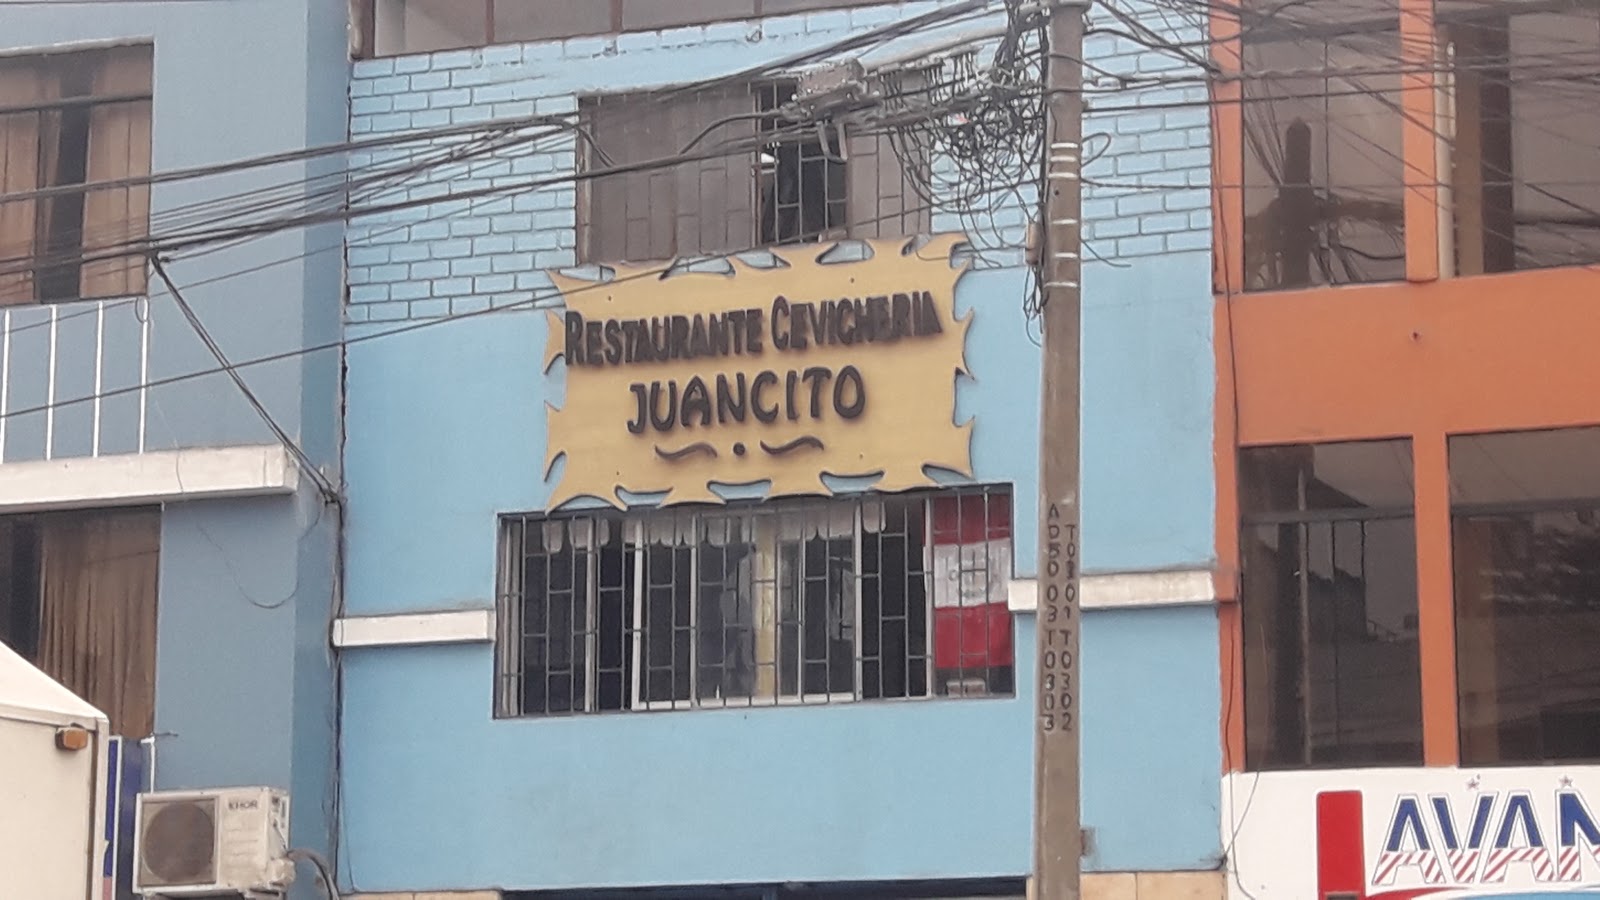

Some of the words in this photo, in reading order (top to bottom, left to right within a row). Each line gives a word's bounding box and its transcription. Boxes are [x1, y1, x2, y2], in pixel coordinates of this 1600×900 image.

[564, 309, 764, 366] RESTAURANTE
[770, 291, 943, 351] CEVICHERIA
[627, 365, 867, 435] JUANCITO
